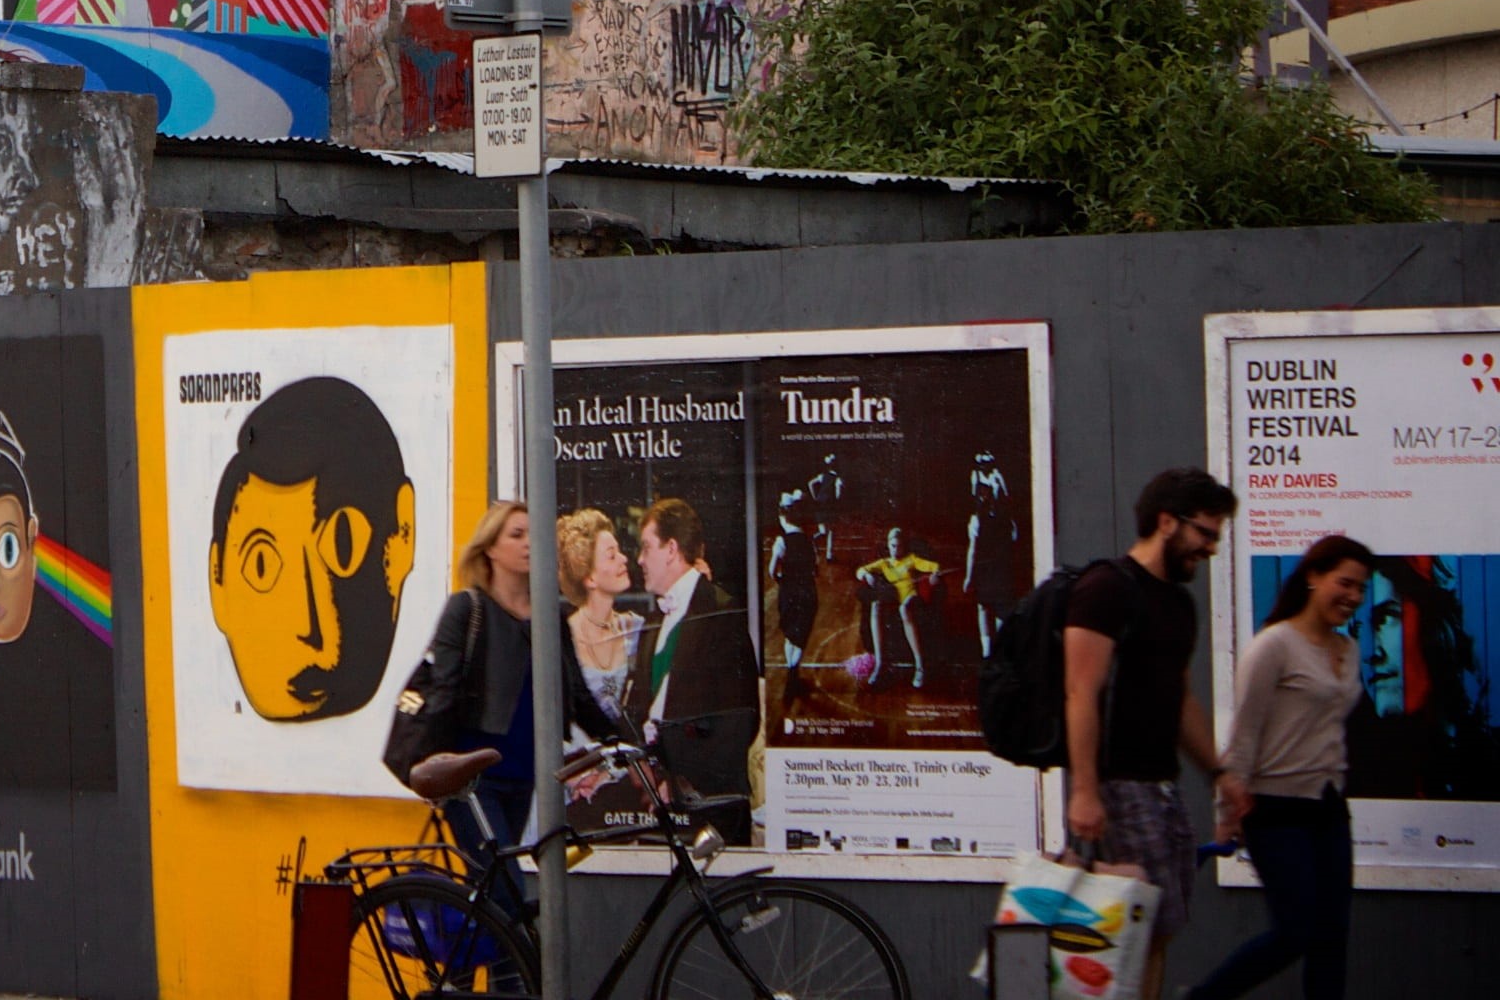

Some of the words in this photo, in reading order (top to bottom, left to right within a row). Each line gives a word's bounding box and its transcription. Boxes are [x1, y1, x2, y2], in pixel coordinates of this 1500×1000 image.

[480, 66, 515, 83] LOADING
[518, 64, 533, 80] BAY
[1247, 359, 1336, 381] DUBLIN
[553, 407, 572, 426] n
[578, 395, 633, 426] Ideal
[638, 391, 746, 424] Husband
[780, 387, 895, 425] Tundra
[1246, 386, 1357, 410] WRITERS
[1248, 415, 1359, 437] FESTIVAL
[1393, 426, 1442, 448] MAY
[612, 429, 683, 459] Wilde
[1248, 445, 1301, 466] 2014
[1248, 474, 1279, 488] RAY
[1283, 473, 1338, 488] DAVIES
[784, 759, 823, 772] Samuel
[826, 759, 864, 772] Beckett
[912, 760, 948, 777] Trinity
[951, 762, 992, 777] College
[832, 773, 852, 789] May
[604, 812, 634, 825] GATE
